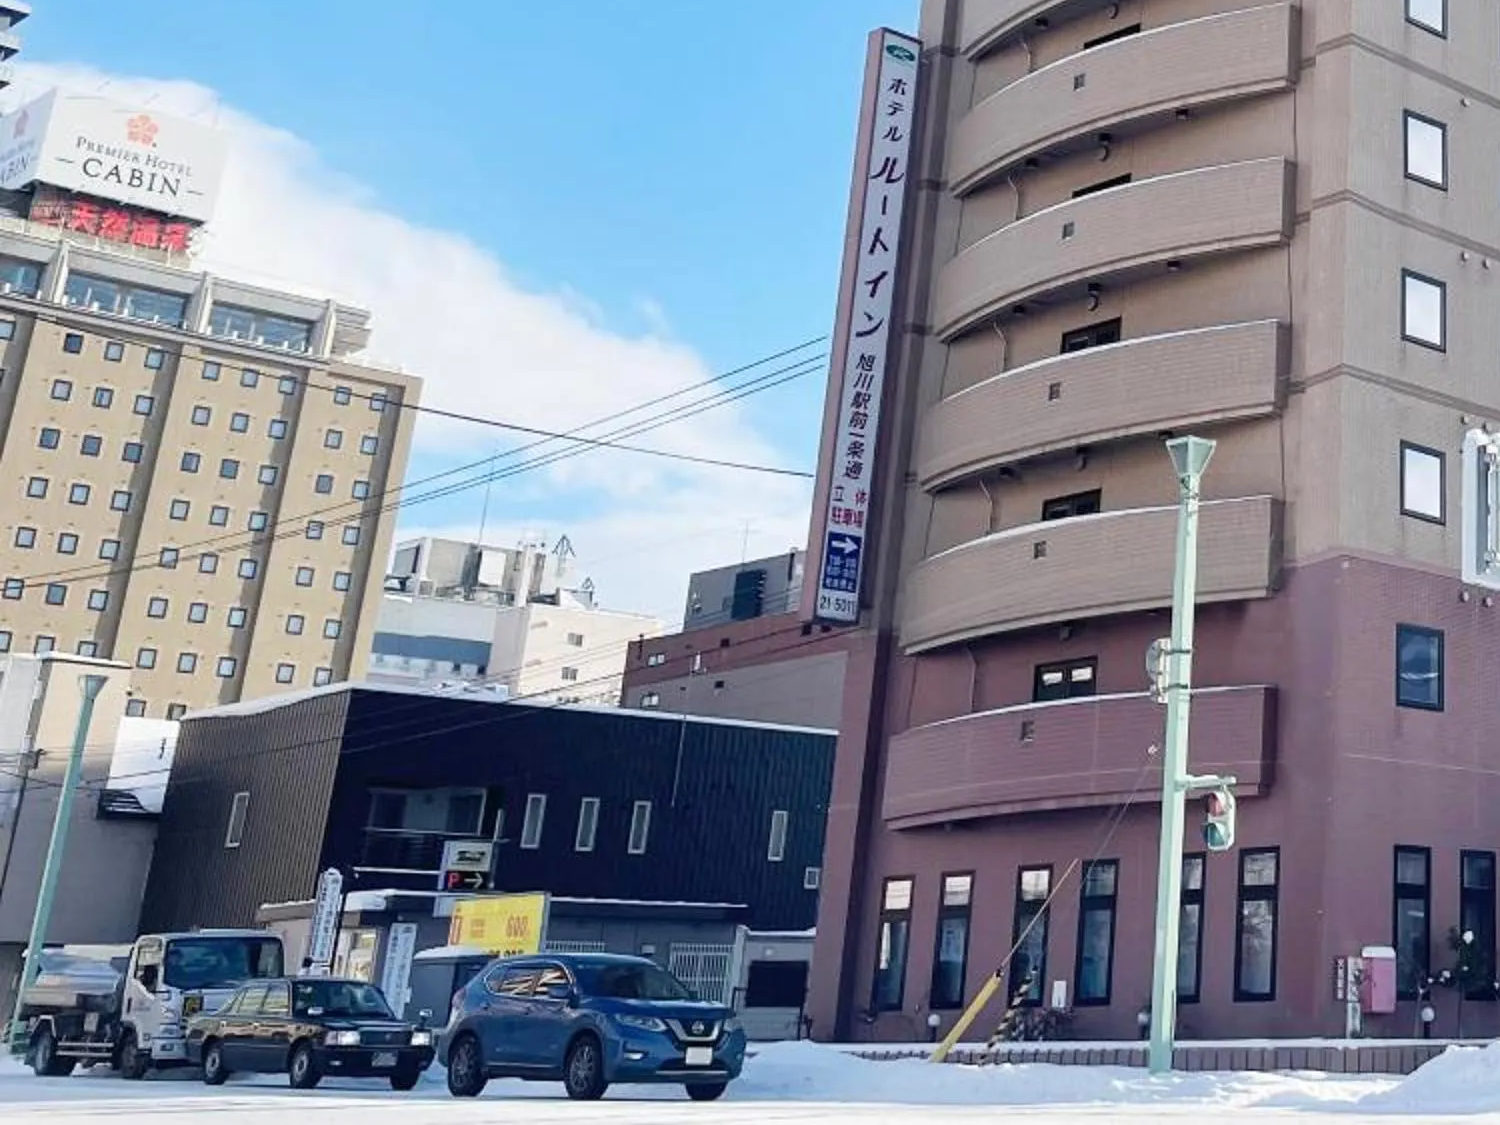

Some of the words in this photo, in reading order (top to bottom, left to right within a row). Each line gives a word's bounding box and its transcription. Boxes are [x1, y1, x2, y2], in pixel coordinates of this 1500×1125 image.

[882, 77, 908, 143] ホテル
[82, 157, 181, 197] CABIN
[854, 155, 905, 338] ルートイン
[447, 872, 461, 889] P
